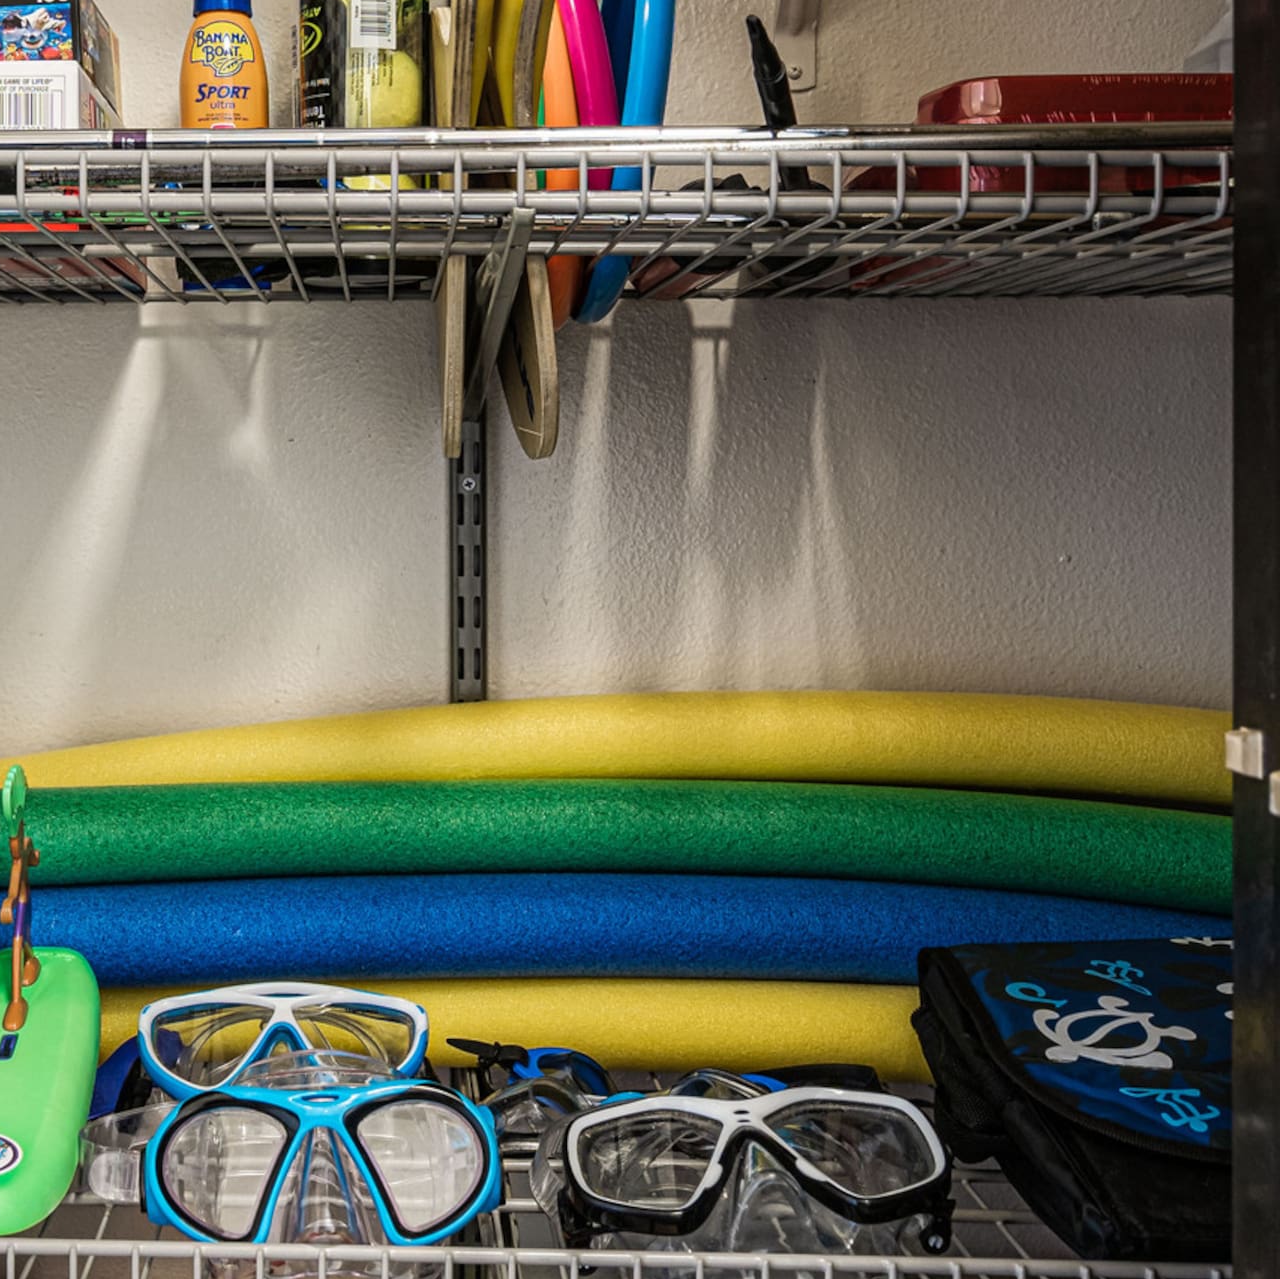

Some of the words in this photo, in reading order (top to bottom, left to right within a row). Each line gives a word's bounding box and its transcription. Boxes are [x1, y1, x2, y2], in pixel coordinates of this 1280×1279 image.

[195, 30, 248, 47] BANANA
[202, 46, 240, 62] BOAT
[195, 83, 251, 103] SPORT
[210, 101, 235, 109] ultra
